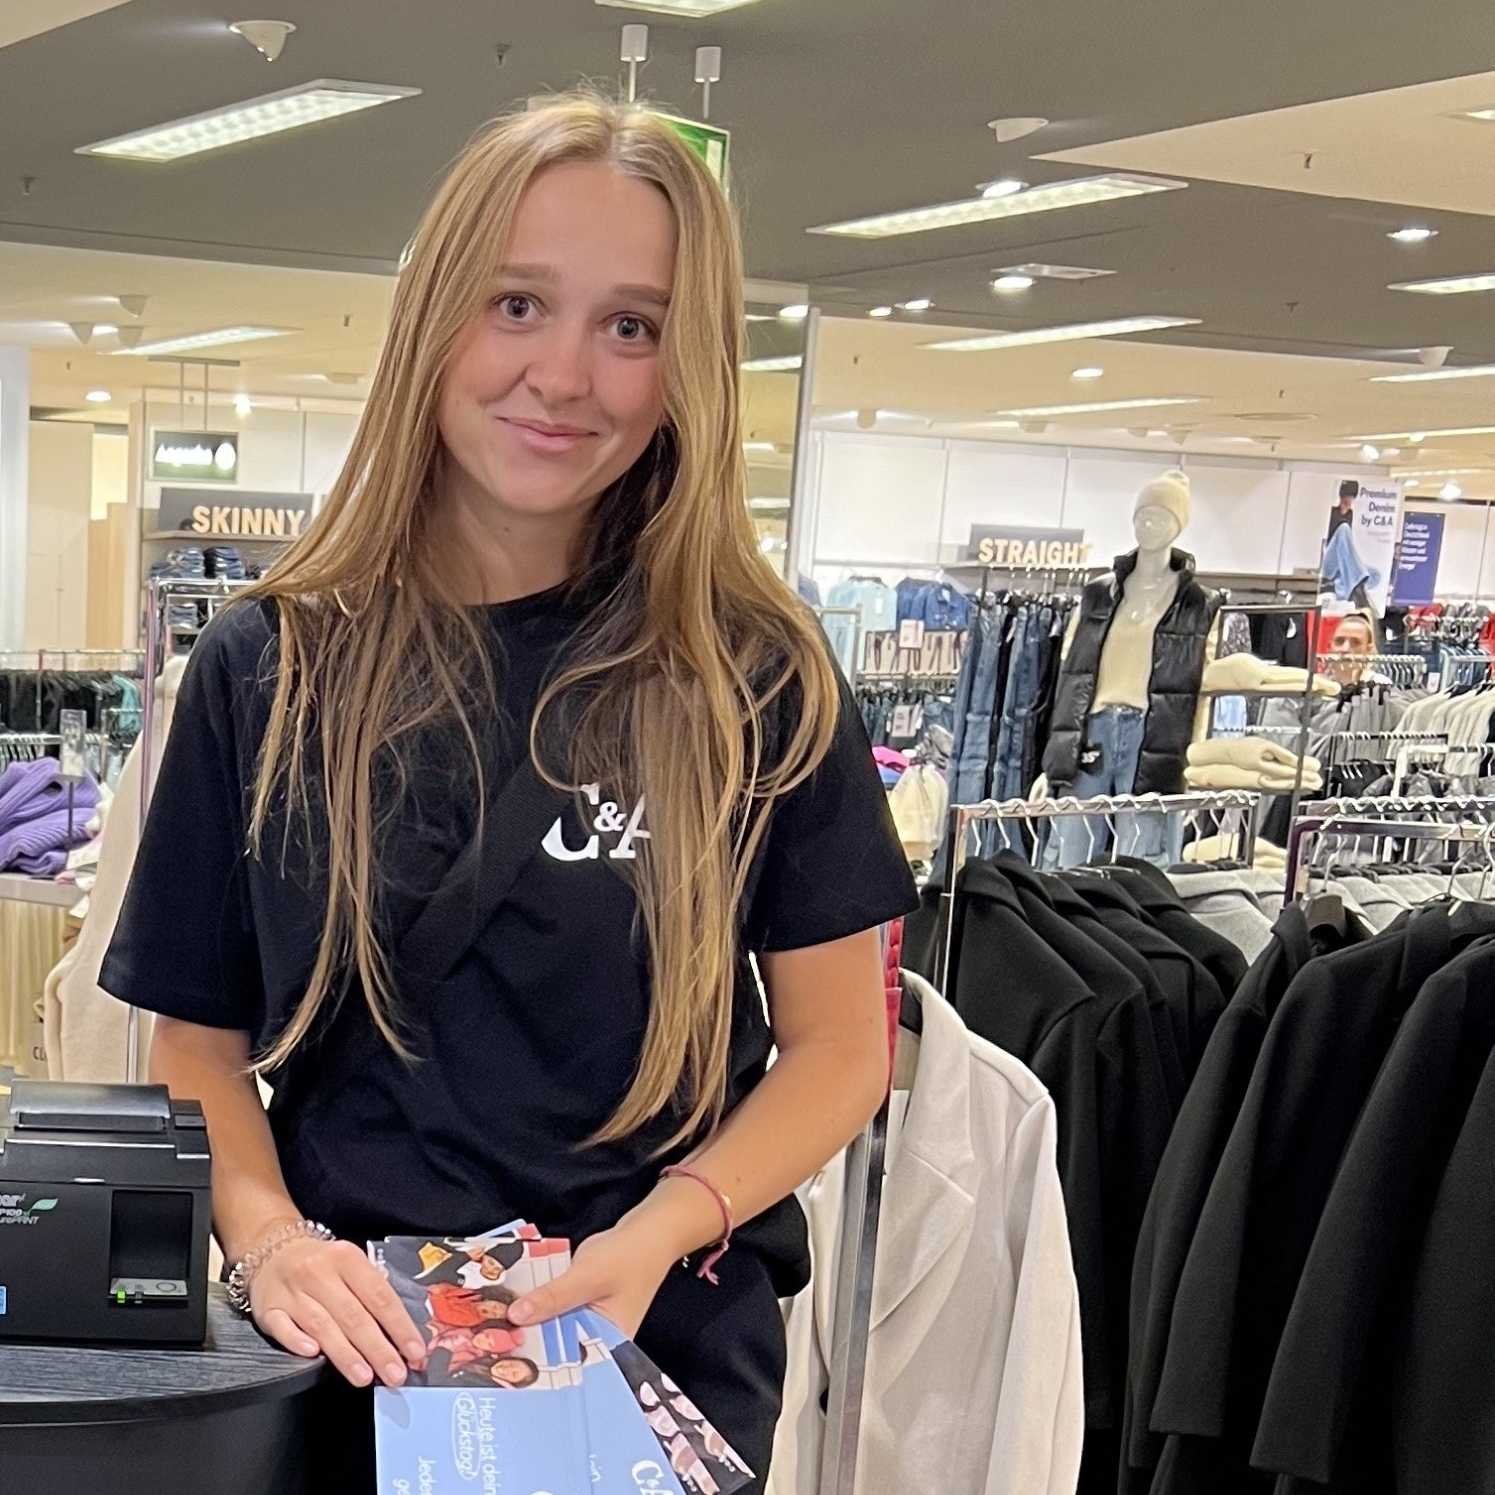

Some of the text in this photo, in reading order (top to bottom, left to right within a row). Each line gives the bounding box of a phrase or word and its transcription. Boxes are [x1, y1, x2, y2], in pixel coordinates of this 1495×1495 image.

[1360, 487, 1397, 499] Premium
[1368, 501, 1395, 513] Denim
[192, 505, 305, 536] SKINNY
[1361, 515, 1372, 527] by
[1373, 515, 1393, 527] C&A
[978, 537, 1093, 566] STRAIGHT
[478, 1397, 497, 1442] Heute
[481, 1443, 499, 1461] ist
